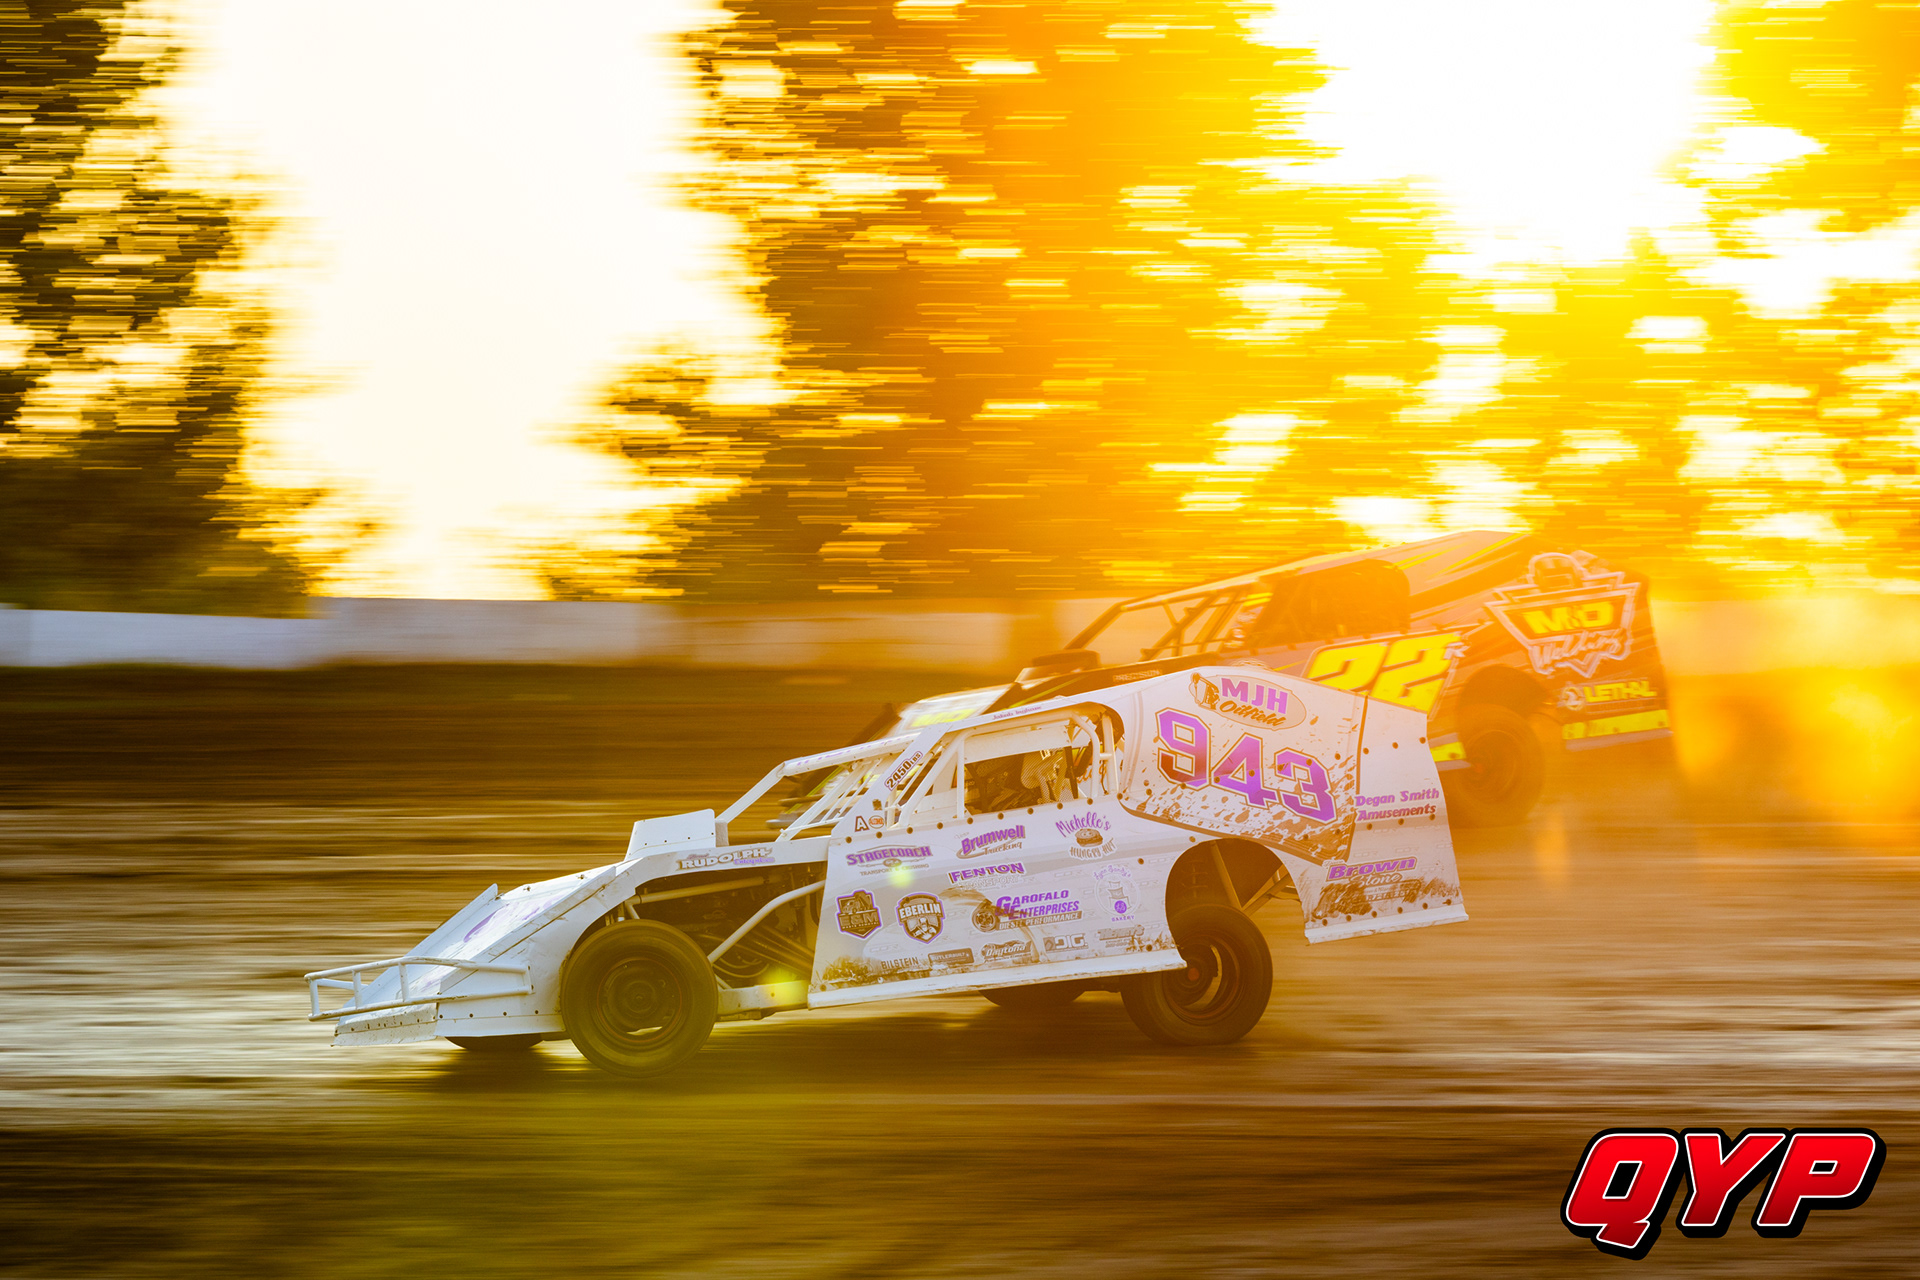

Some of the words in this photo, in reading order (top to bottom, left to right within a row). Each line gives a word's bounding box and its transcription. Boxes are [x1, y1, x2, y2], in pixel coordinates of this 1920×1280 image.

[1221, 677, 1288, 714] MJH
[1583, 680, 1658, 703] LETHAL
[1219, 700, 1286, 727] Oilfield
[1155, 707, 1338, 825] 943
[1354, 794, 1395, 807] Degan
[1399, 788, 1440, 802] Smith
[1357, 804, 1437, 821] Amusements
[855, 815, 870, 832] A
[1055, 811, 1111, 838] Michelle's
[961, 824, 1026, 855] Brumwell
[983, 841, 1023, 856] Trucking
[681, 847, 770, 869] RUDOLPH
[846, 845, 932, 866] STAGECOACH
[1069, 846, 1102, 859] HUNGRY
[949, 862, 1025, 884] FENTON
[1328, 858, 1416, 880] Brown
[1349, 873, 1402, 889] Stone
[899, 903, 942, 919] EBERLIN
[996, 889, 1069, 915] GAROFALO
[1008, 900, 1080, 920] ENTERPRISES
[999, 919, 1027, 930] DIESEL
[1025, 911, 1081, 926] PERFORMANCE
[1111, 914, 1135, 923] BAKERY
[985, 944, 1026, 957] Daytona
[881, 956, 919, 970] BILSTEIN
